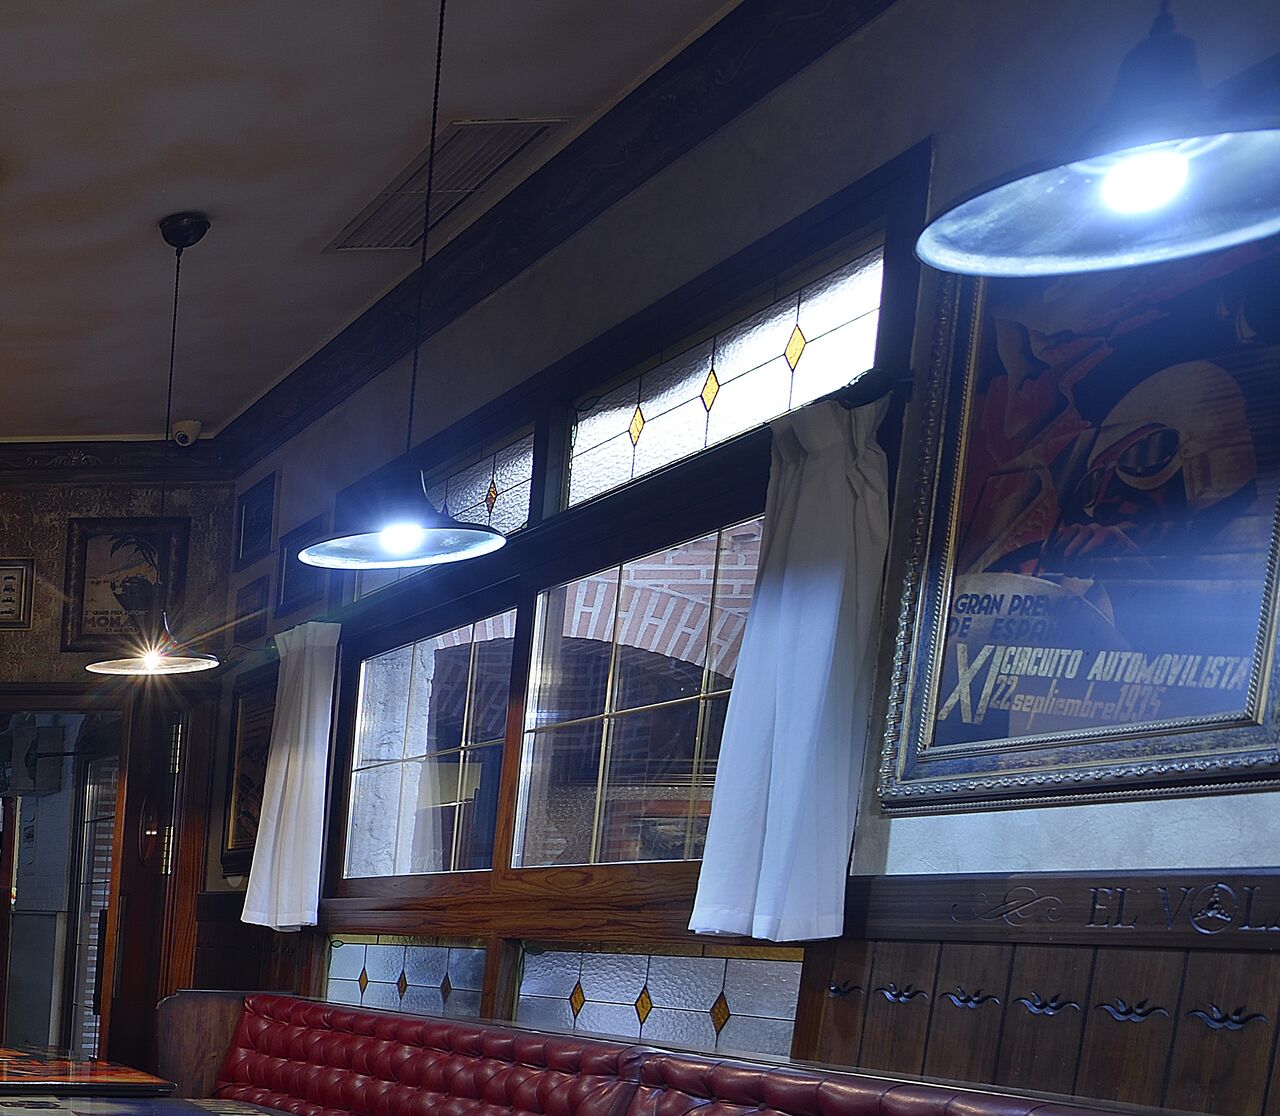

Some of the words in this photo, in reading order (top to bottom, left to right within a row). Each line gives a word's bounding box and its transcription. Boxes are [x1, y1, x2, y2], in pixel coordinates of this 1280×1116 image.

[953, 594, 1005, 616] GRAN
[948, 616, 973, 639] DE
[937, 643, 1006, 725] XI
[999, 646, 1083, 679] CIRCUITO
[1087, 650, 1252, 691] AUTOMOVILISTA
[989, 675, 1018, 711] 22
[1011, 678, 1117, 731] septiembre
[1085, 886, 1138, 928] EL
